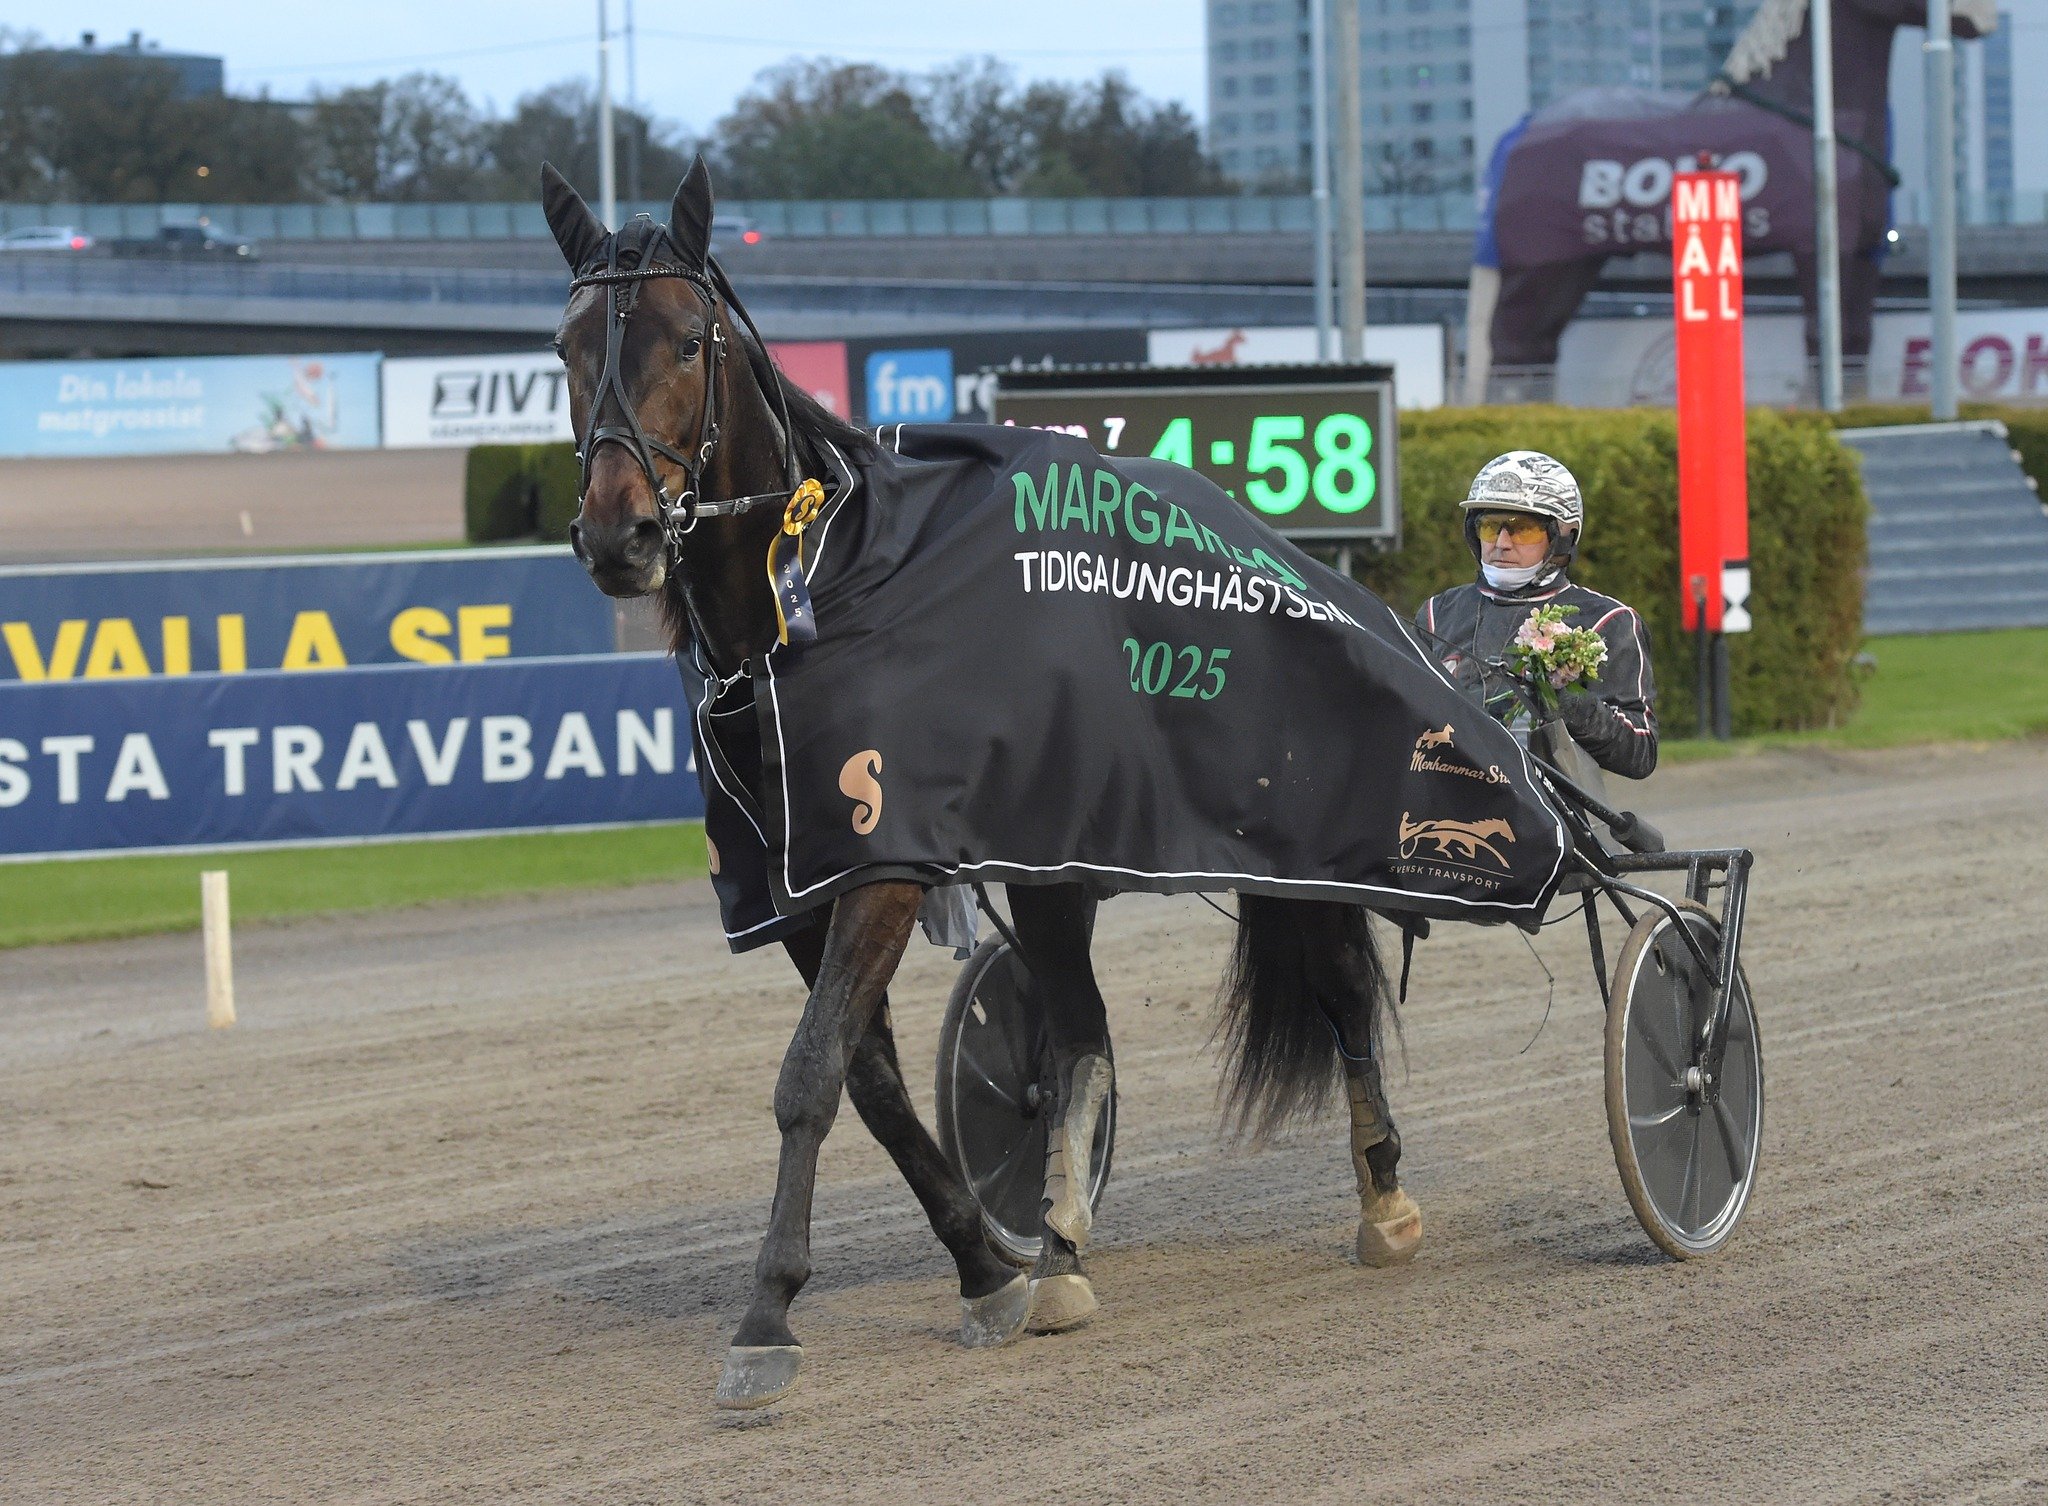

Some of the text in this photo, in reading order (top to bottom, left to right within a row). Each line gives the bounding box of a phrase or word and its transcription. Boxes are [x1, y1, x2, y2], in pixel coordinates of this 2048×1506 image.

[1583, 205, 1770, 244] stas
[1675, 180, 1711, 322] MÅL
[487, 371, 566, 414] IVT
[876, 361, 945, 416] fm
[1103, 417, 1126, 450] 7
[1123, 637, 1231, 700] 2025
[0, 707, 697, 807] STA TRAVBAN
[1410, 749, 1485, 780] Menhammar
[1389, 865, 1500, 890] SVENSK TRAVSPORT
